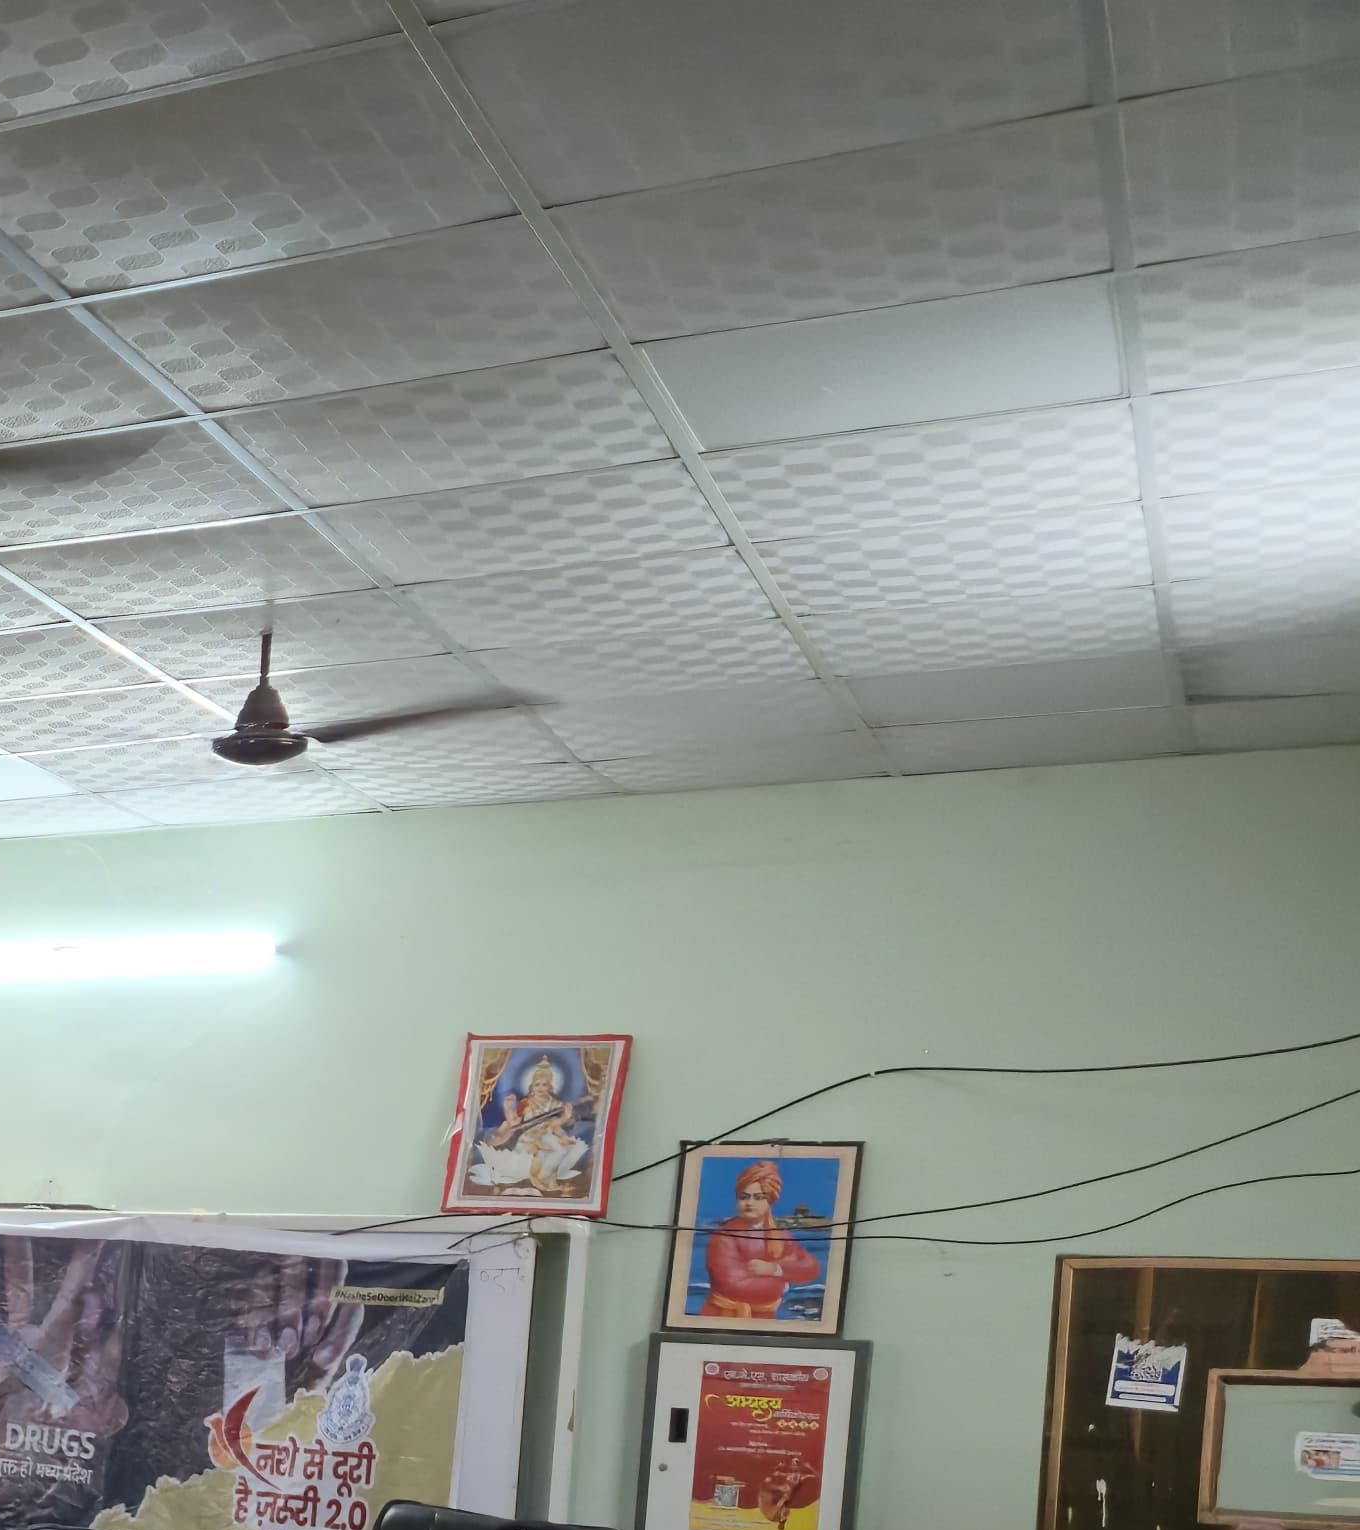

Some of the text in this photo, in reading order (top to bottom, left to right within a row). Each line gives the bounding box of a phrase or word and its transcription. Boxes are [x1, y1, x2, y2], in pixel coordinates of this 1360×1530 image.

[5, 1422, 97, 1460] DRUGS
[19, 1456, 33, 1478] हो
[256, 1436, 376, 1498] नशे से दूरी
[234, 1476, 252, 1523] है
